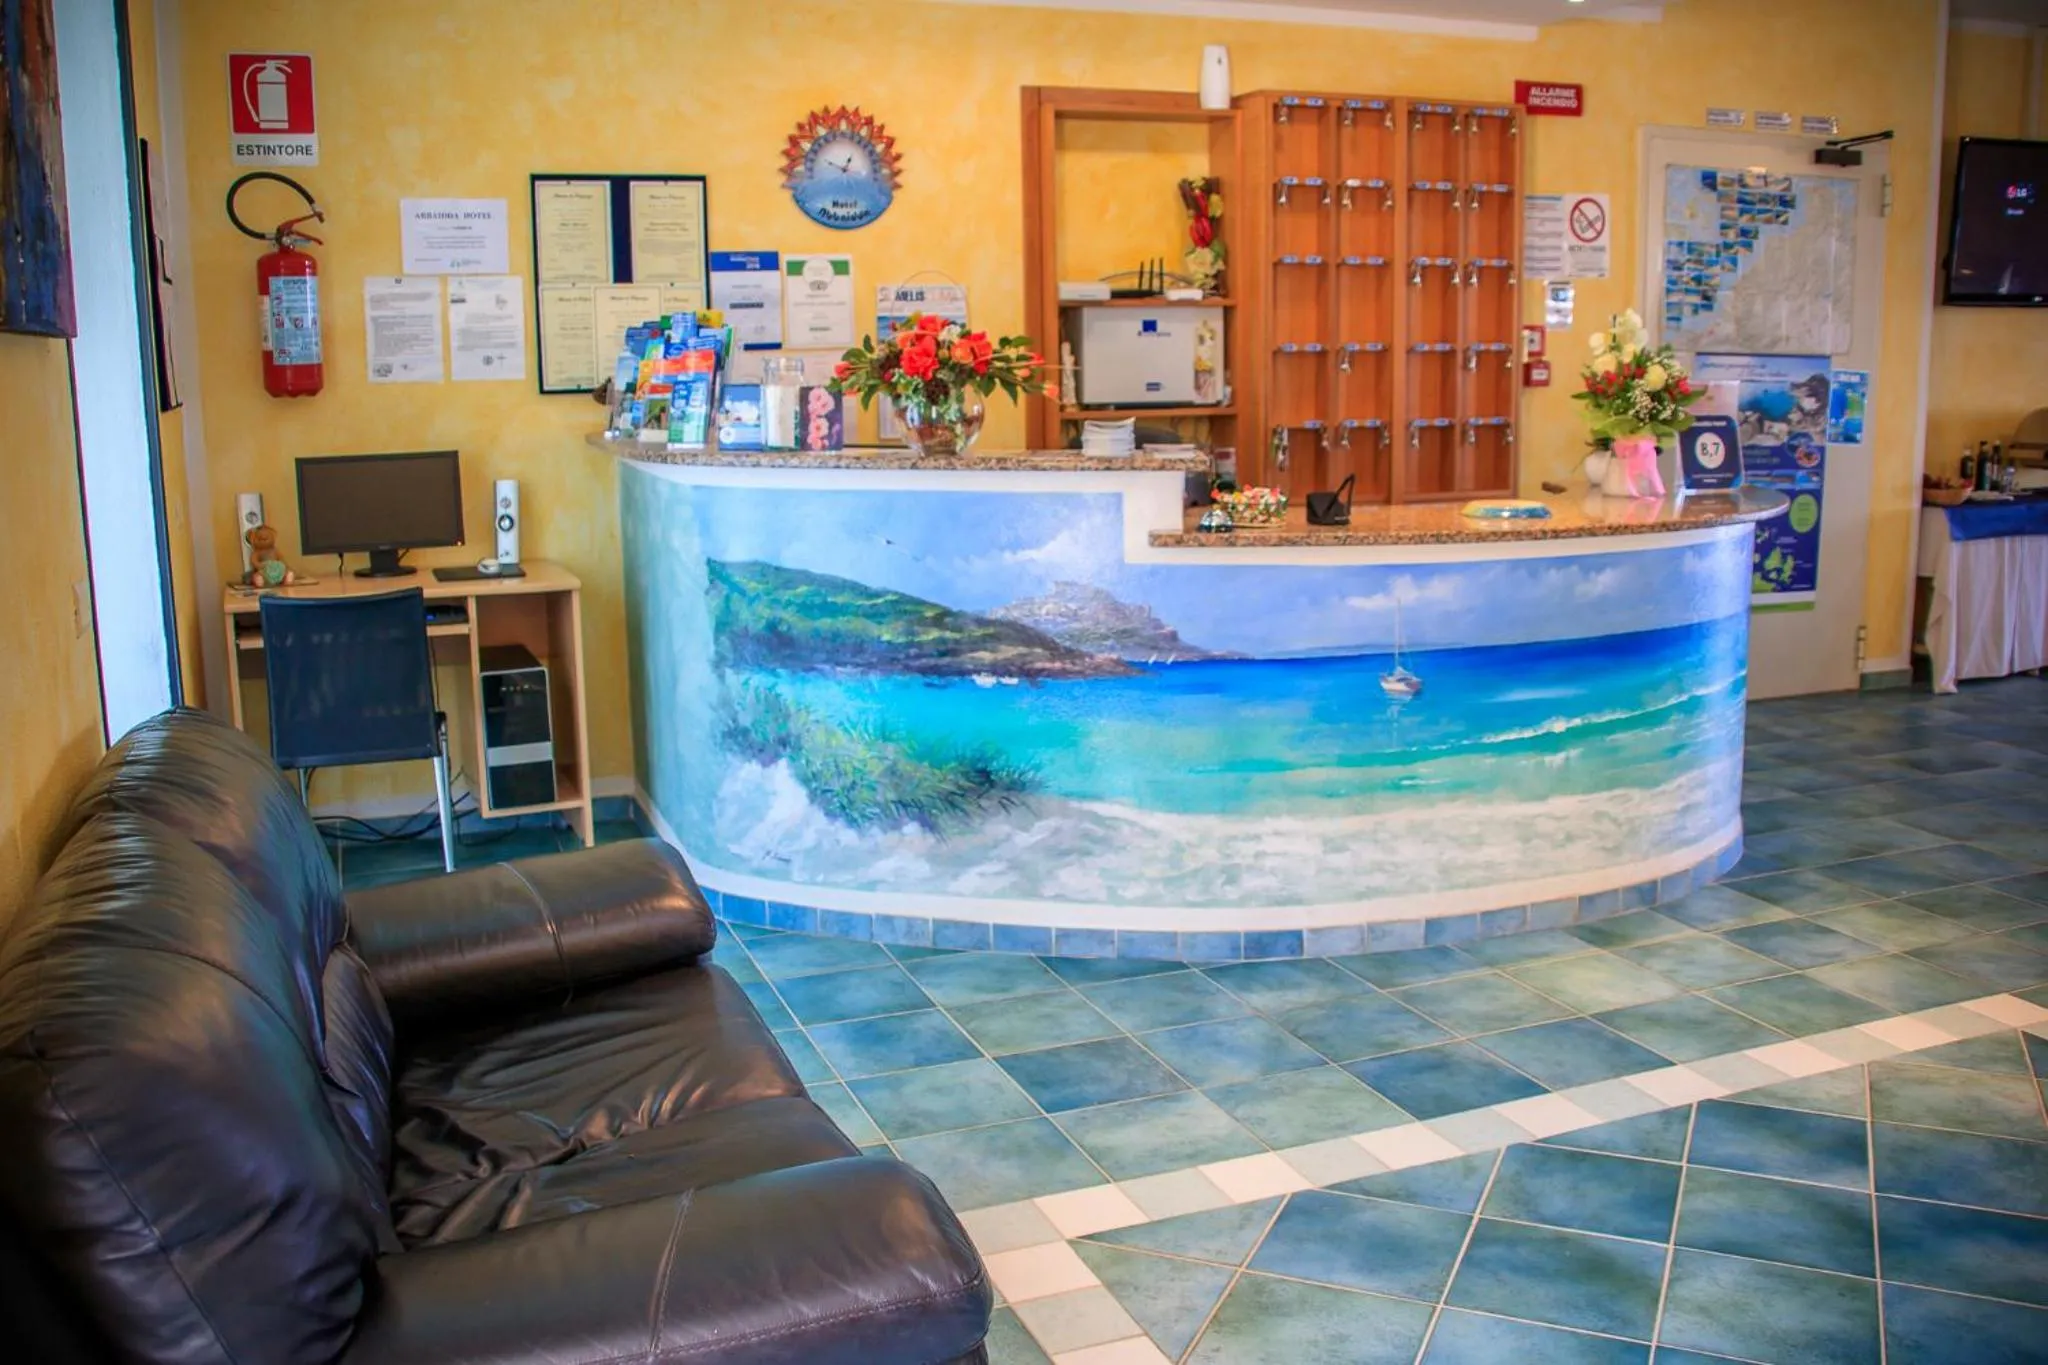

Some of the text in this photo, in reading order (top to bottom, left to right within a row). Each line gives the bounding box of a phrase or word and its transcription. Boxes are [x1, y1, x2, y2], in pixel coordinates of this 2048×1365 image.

[1529, 87, 1577, 97] ALLARME
[1528, 97, 1578, 108] INCENDIO
[236, 144, 313, 156] ESTINTORE
